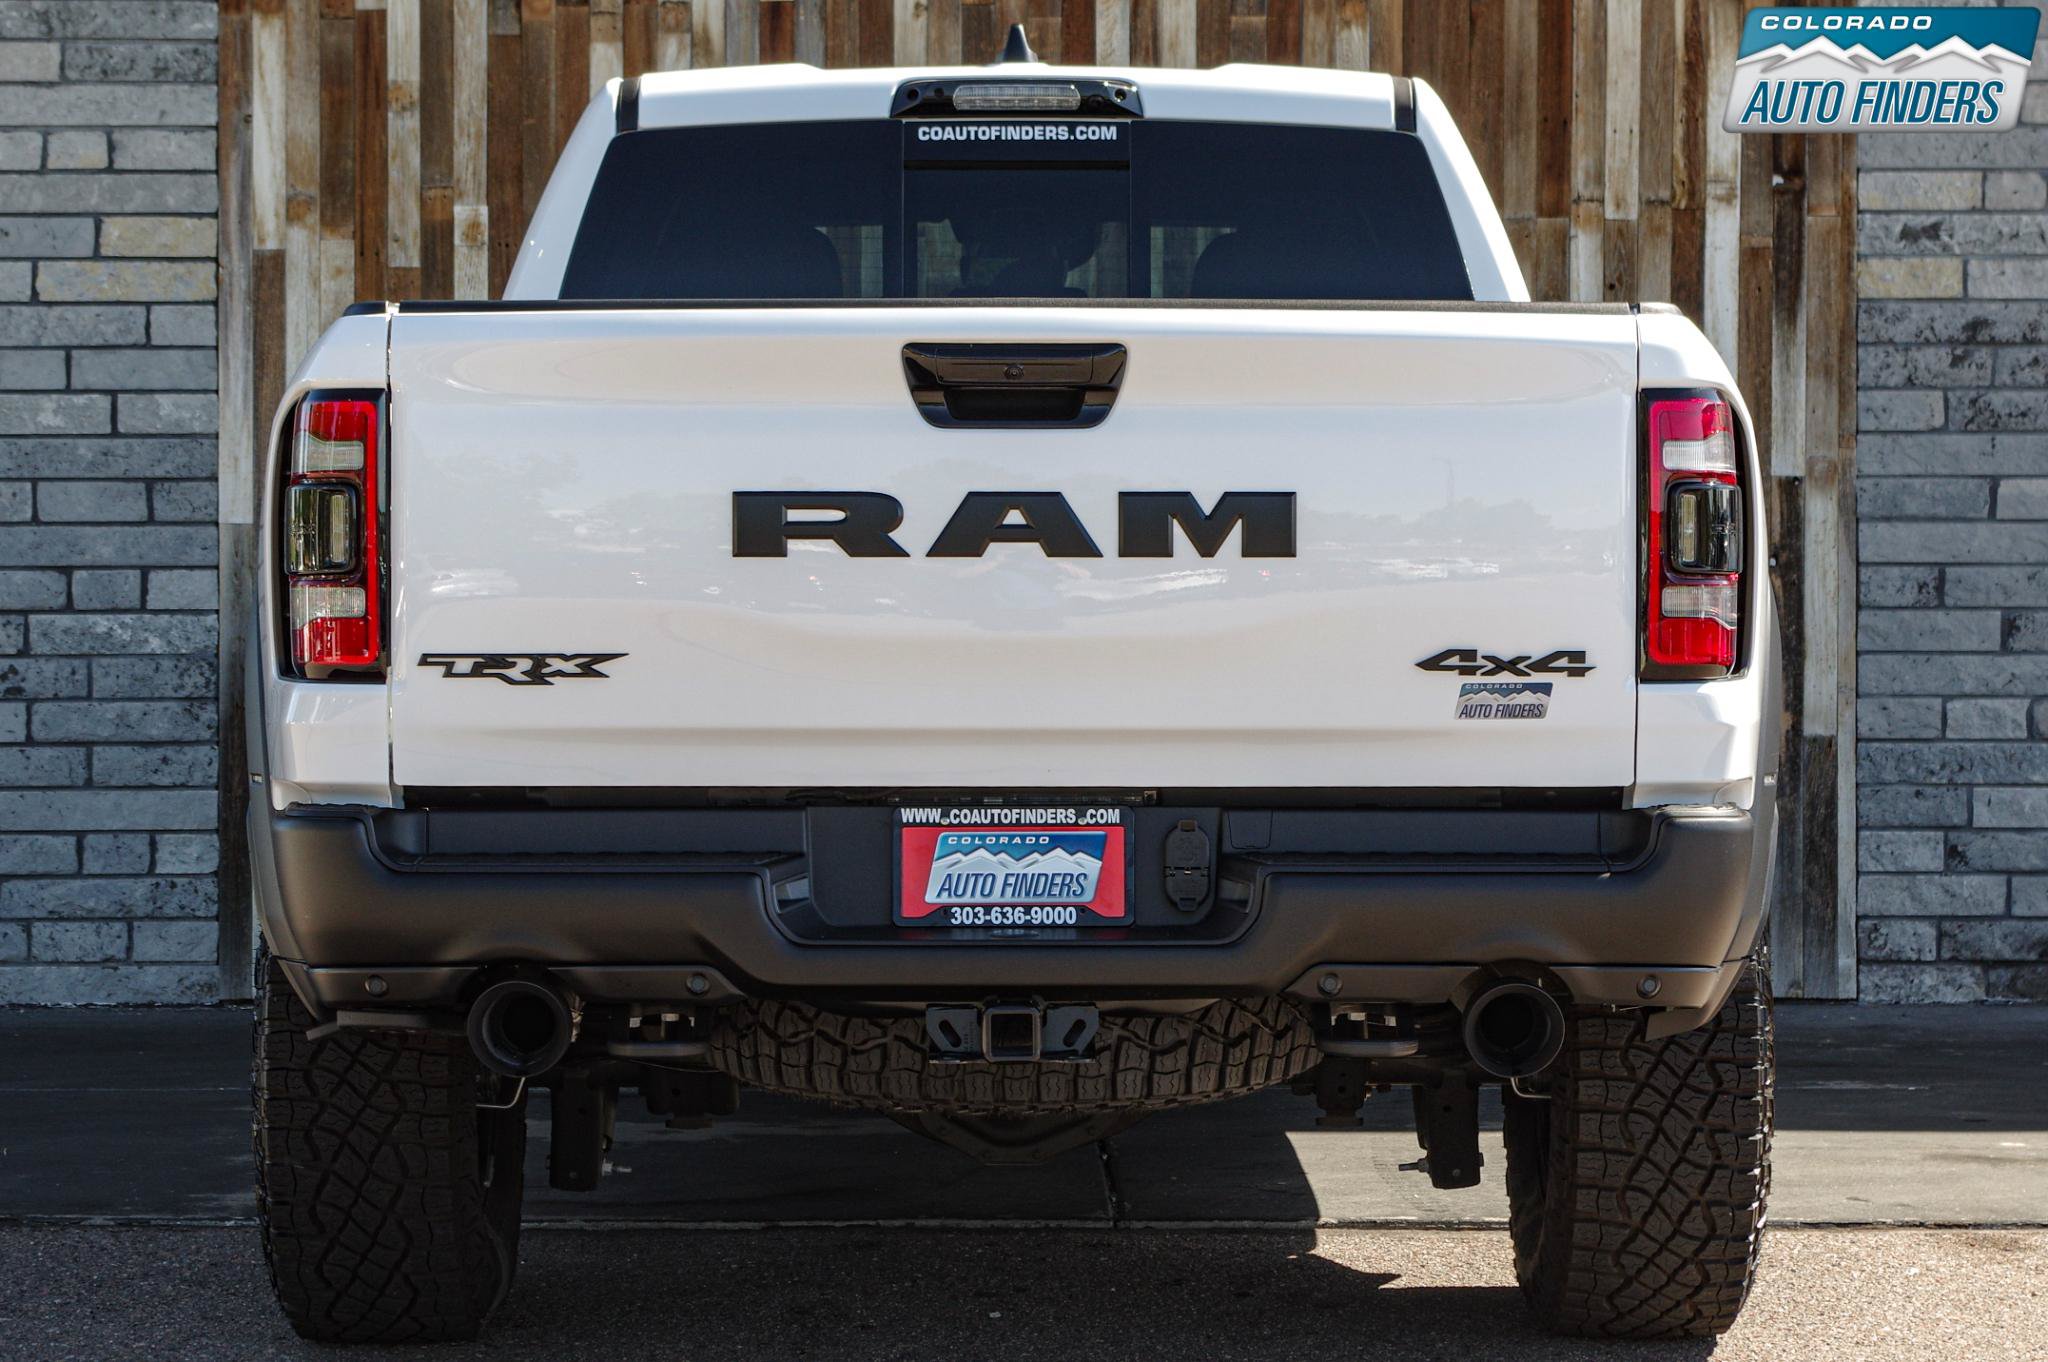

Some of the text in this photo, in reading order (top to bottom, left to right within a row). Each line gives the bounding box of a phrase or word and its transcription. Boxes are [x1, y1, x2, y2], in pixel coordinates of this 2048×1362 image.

[918, 126, 1118, 141] COAUTOFINDERS.COM
[732, 490, 1297, 558] RAM
[417, 653, 629, 685] TRX
[1458, 703, 1544, 719] AUTO FINDERS
[948, 836, 1050, 844] COLORADO
[936, 872, 1088, 899] AUTO FINDERS
[950, 906, 1077, 925] 303-636-9000
